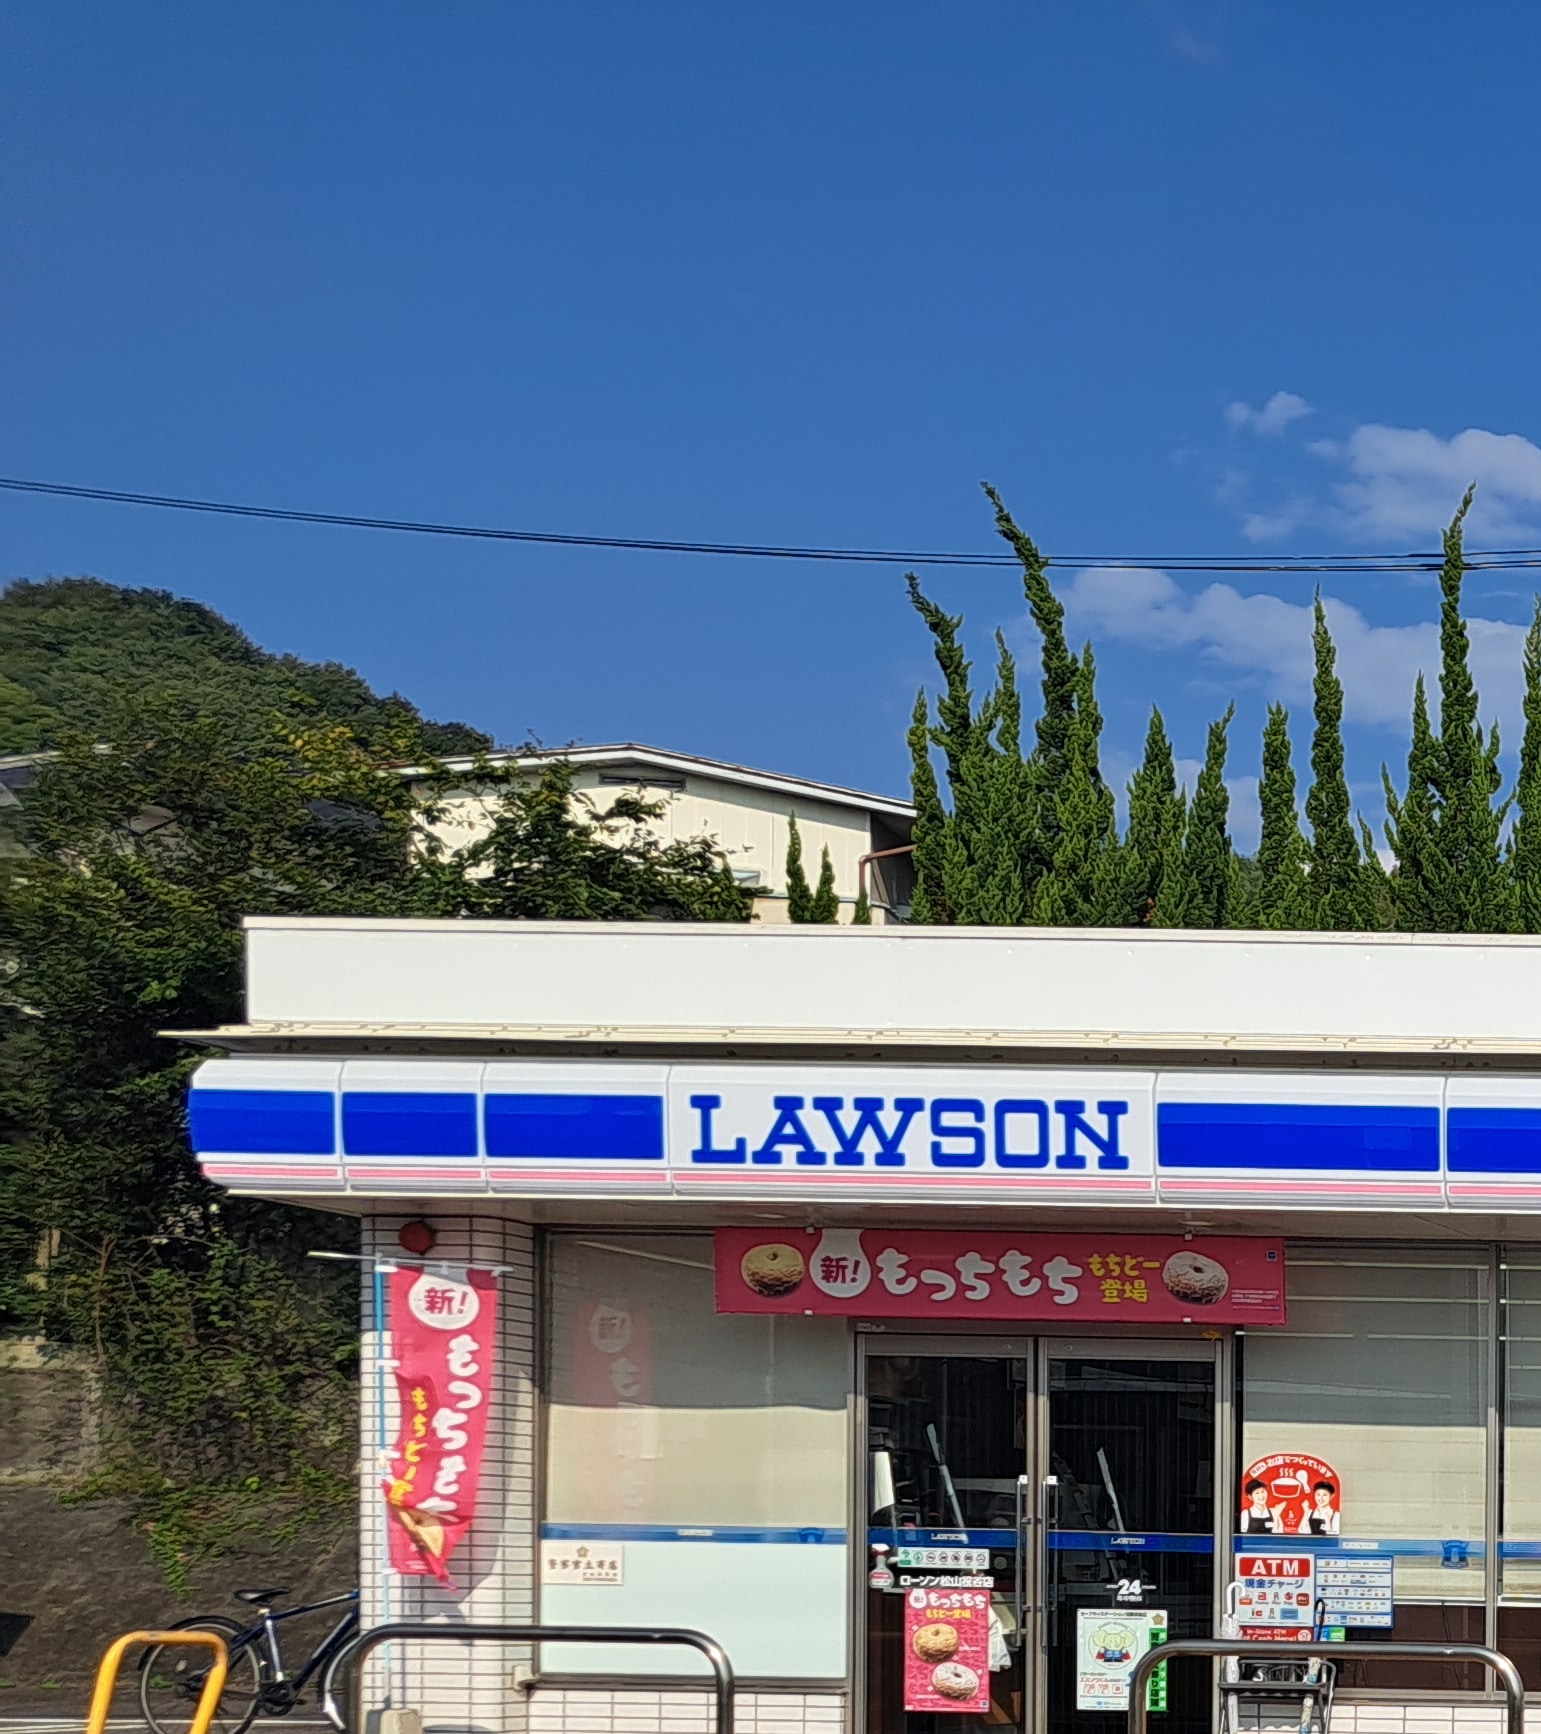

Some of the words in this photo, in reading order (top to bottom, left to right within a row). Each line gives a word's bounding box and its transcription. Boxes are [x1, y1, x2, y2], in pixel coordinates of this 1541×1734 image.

[690, 1093, 1129, 1171] LAWSON
[820, 1254, 861, 1285] 新!
[876, 1247, 1084, 1305] もっちもち
[1088, 1253, 1162, 1276] もちどー
[424, 1286, 469, 1316] 新!
[1101, 1279, 1150, 1303] 登場
[1251, 1559, 1299, 1576] ATM
[1117, 1578, 1142, 1595] 24
[1245, 1578, 1305, 1590] 現金チャージ
[928, 1590, 987, 1609] もっちもち
